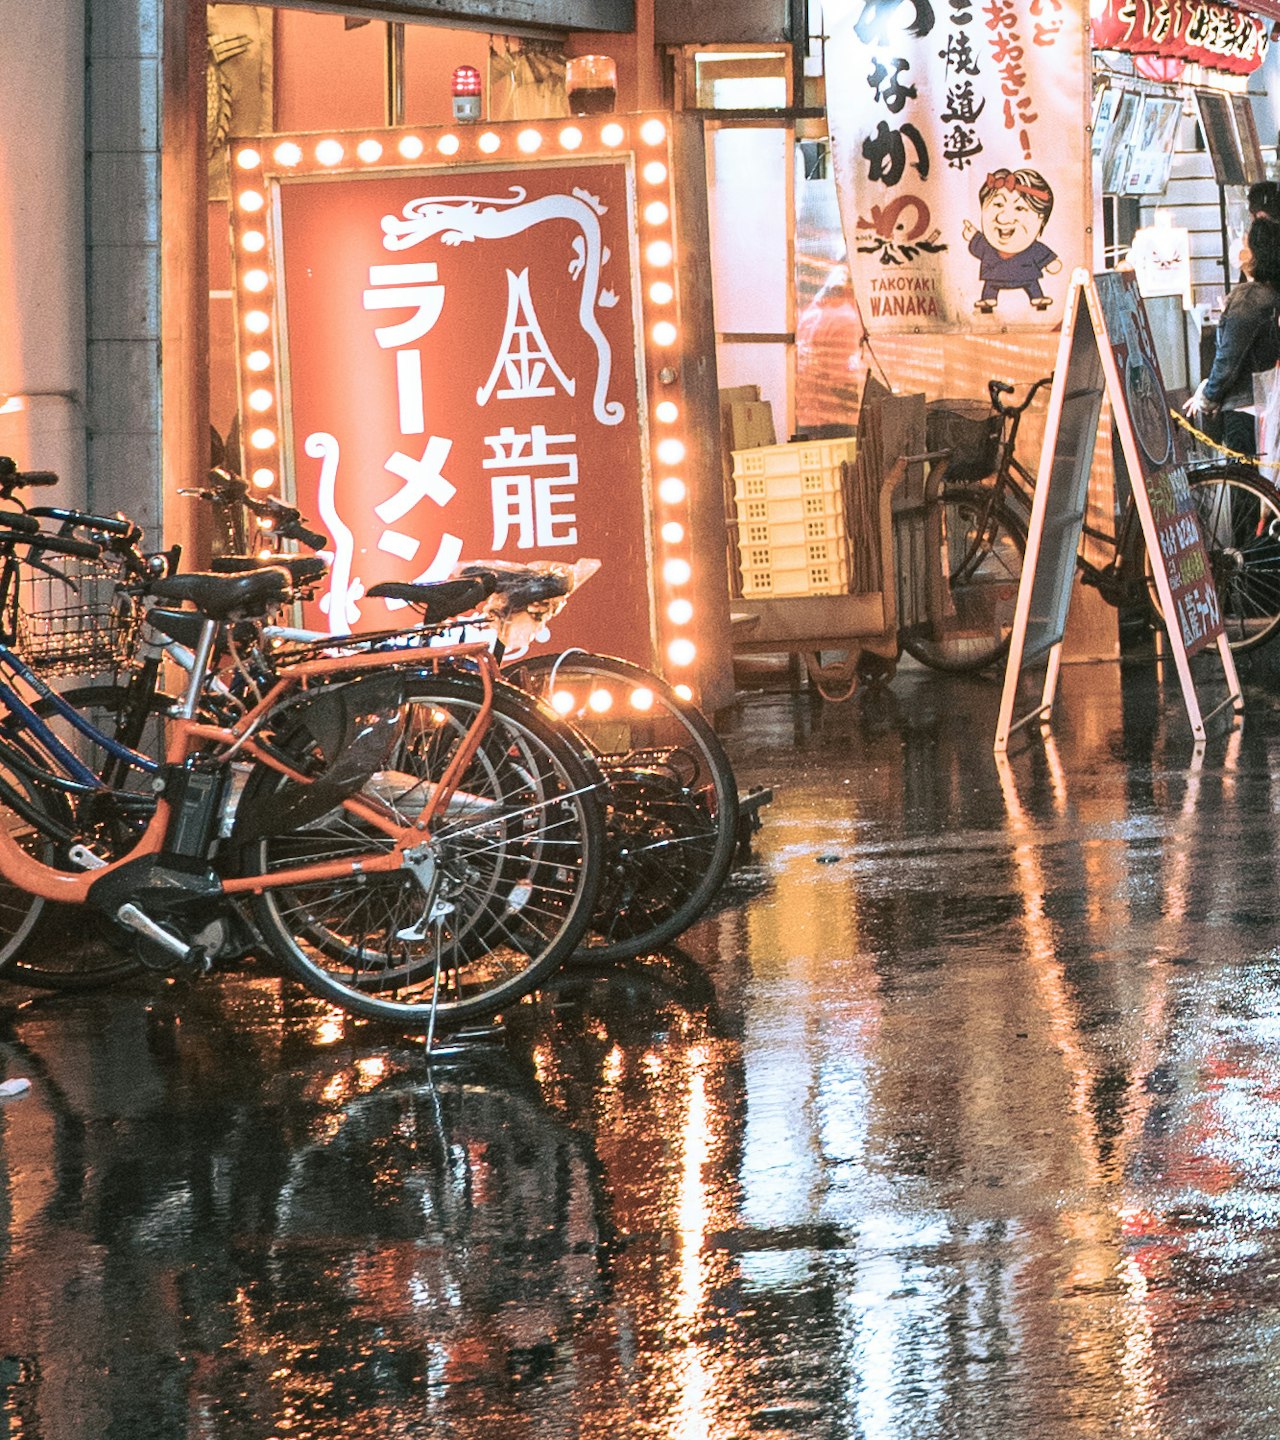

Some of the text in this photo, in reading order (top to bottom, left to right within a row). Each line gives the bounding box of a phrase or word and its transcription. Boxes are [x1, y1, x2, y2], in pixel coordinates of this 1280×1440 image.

[869, 295, 938, 318] WANAKA
[870, 276, 936, 292] TAKOYAKI
[362, 261, 463, 610] ラーメン
[478, 267, 578, 549] 金龍
